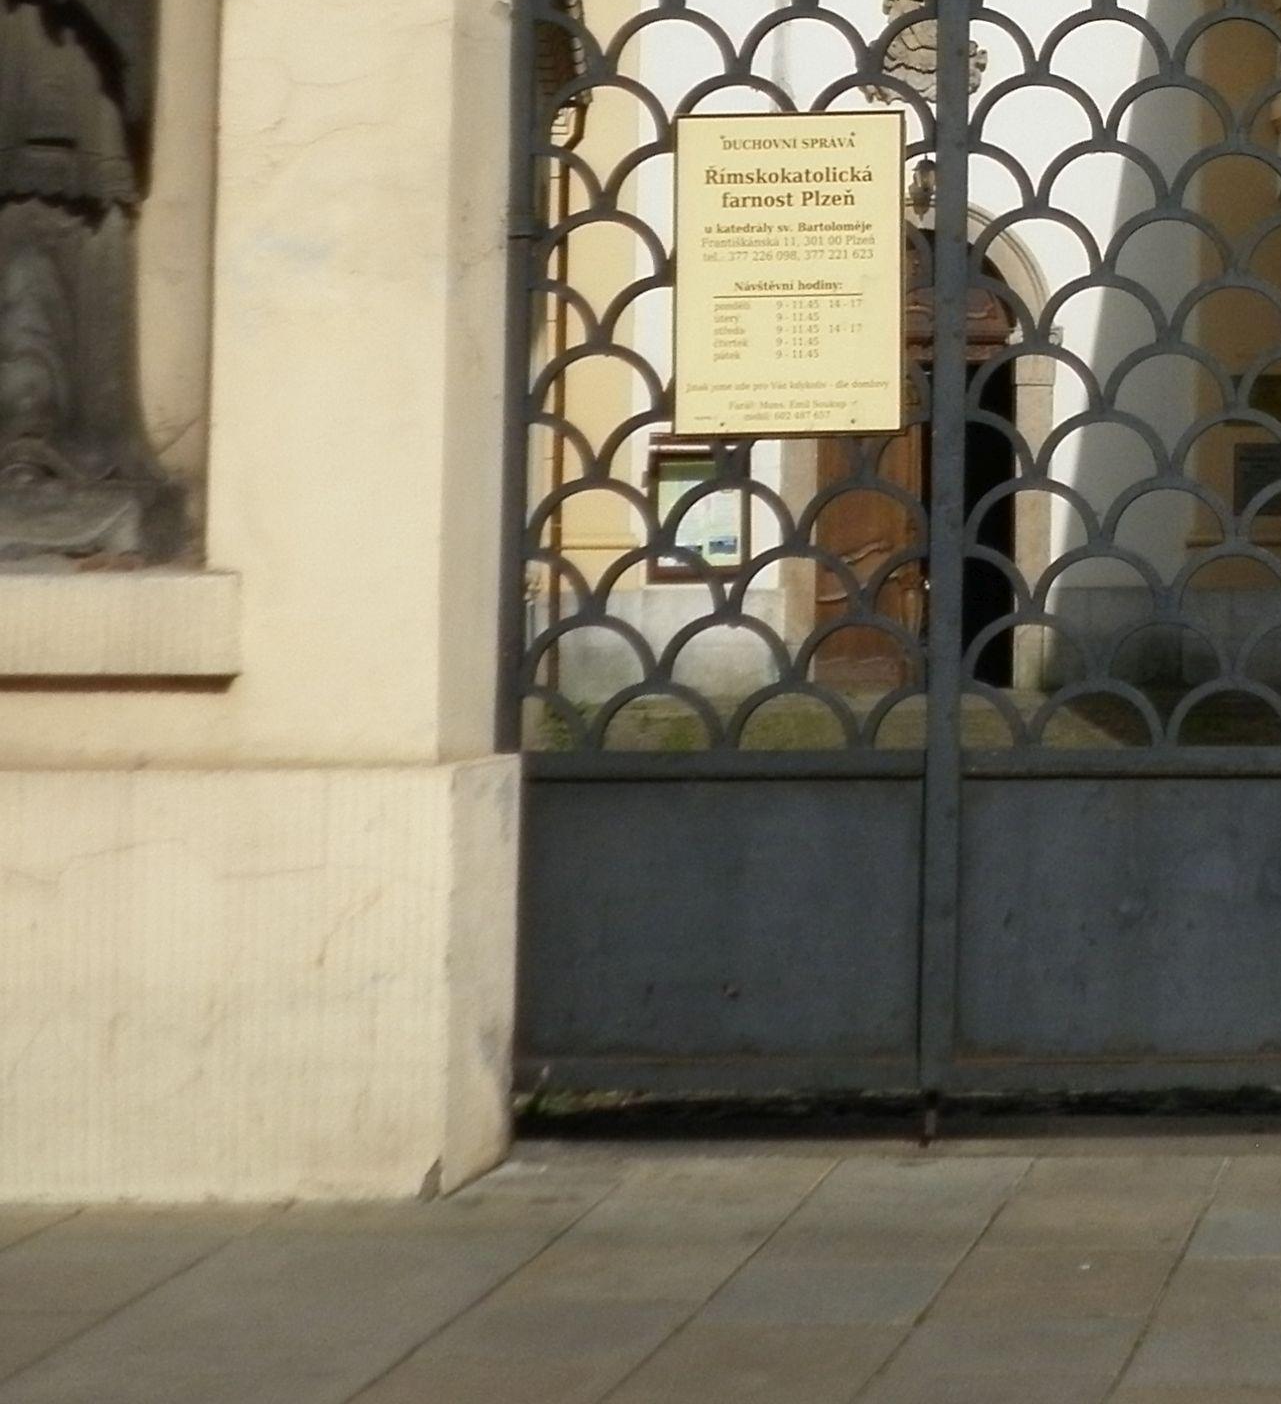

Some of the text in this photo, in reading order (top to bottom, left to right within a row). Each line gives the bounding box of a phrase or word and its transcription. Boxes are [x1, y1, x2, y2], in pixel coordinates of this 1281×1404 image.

[705, 165, 873, 185] Římskokatolická
[721, 188, 855, 208] farnost Plzeň
[716, 223, 773, 235] katedrály
[797, 221, 872, 232] Bartoloměje
[804, 236, 823, 246] 301
[827, 236, 842, 245] 00
[845, 235, 875, 245] Plzeň
[728, 251, 748, 261] 377
[752, 251, 773, 261] 226
[804, 250, 824, 260] 377
[829, 250, 848, 259] 221
[852, 249, 873, 259] 623
[734, 280, 843, 291] Návštěvní hodiny:
